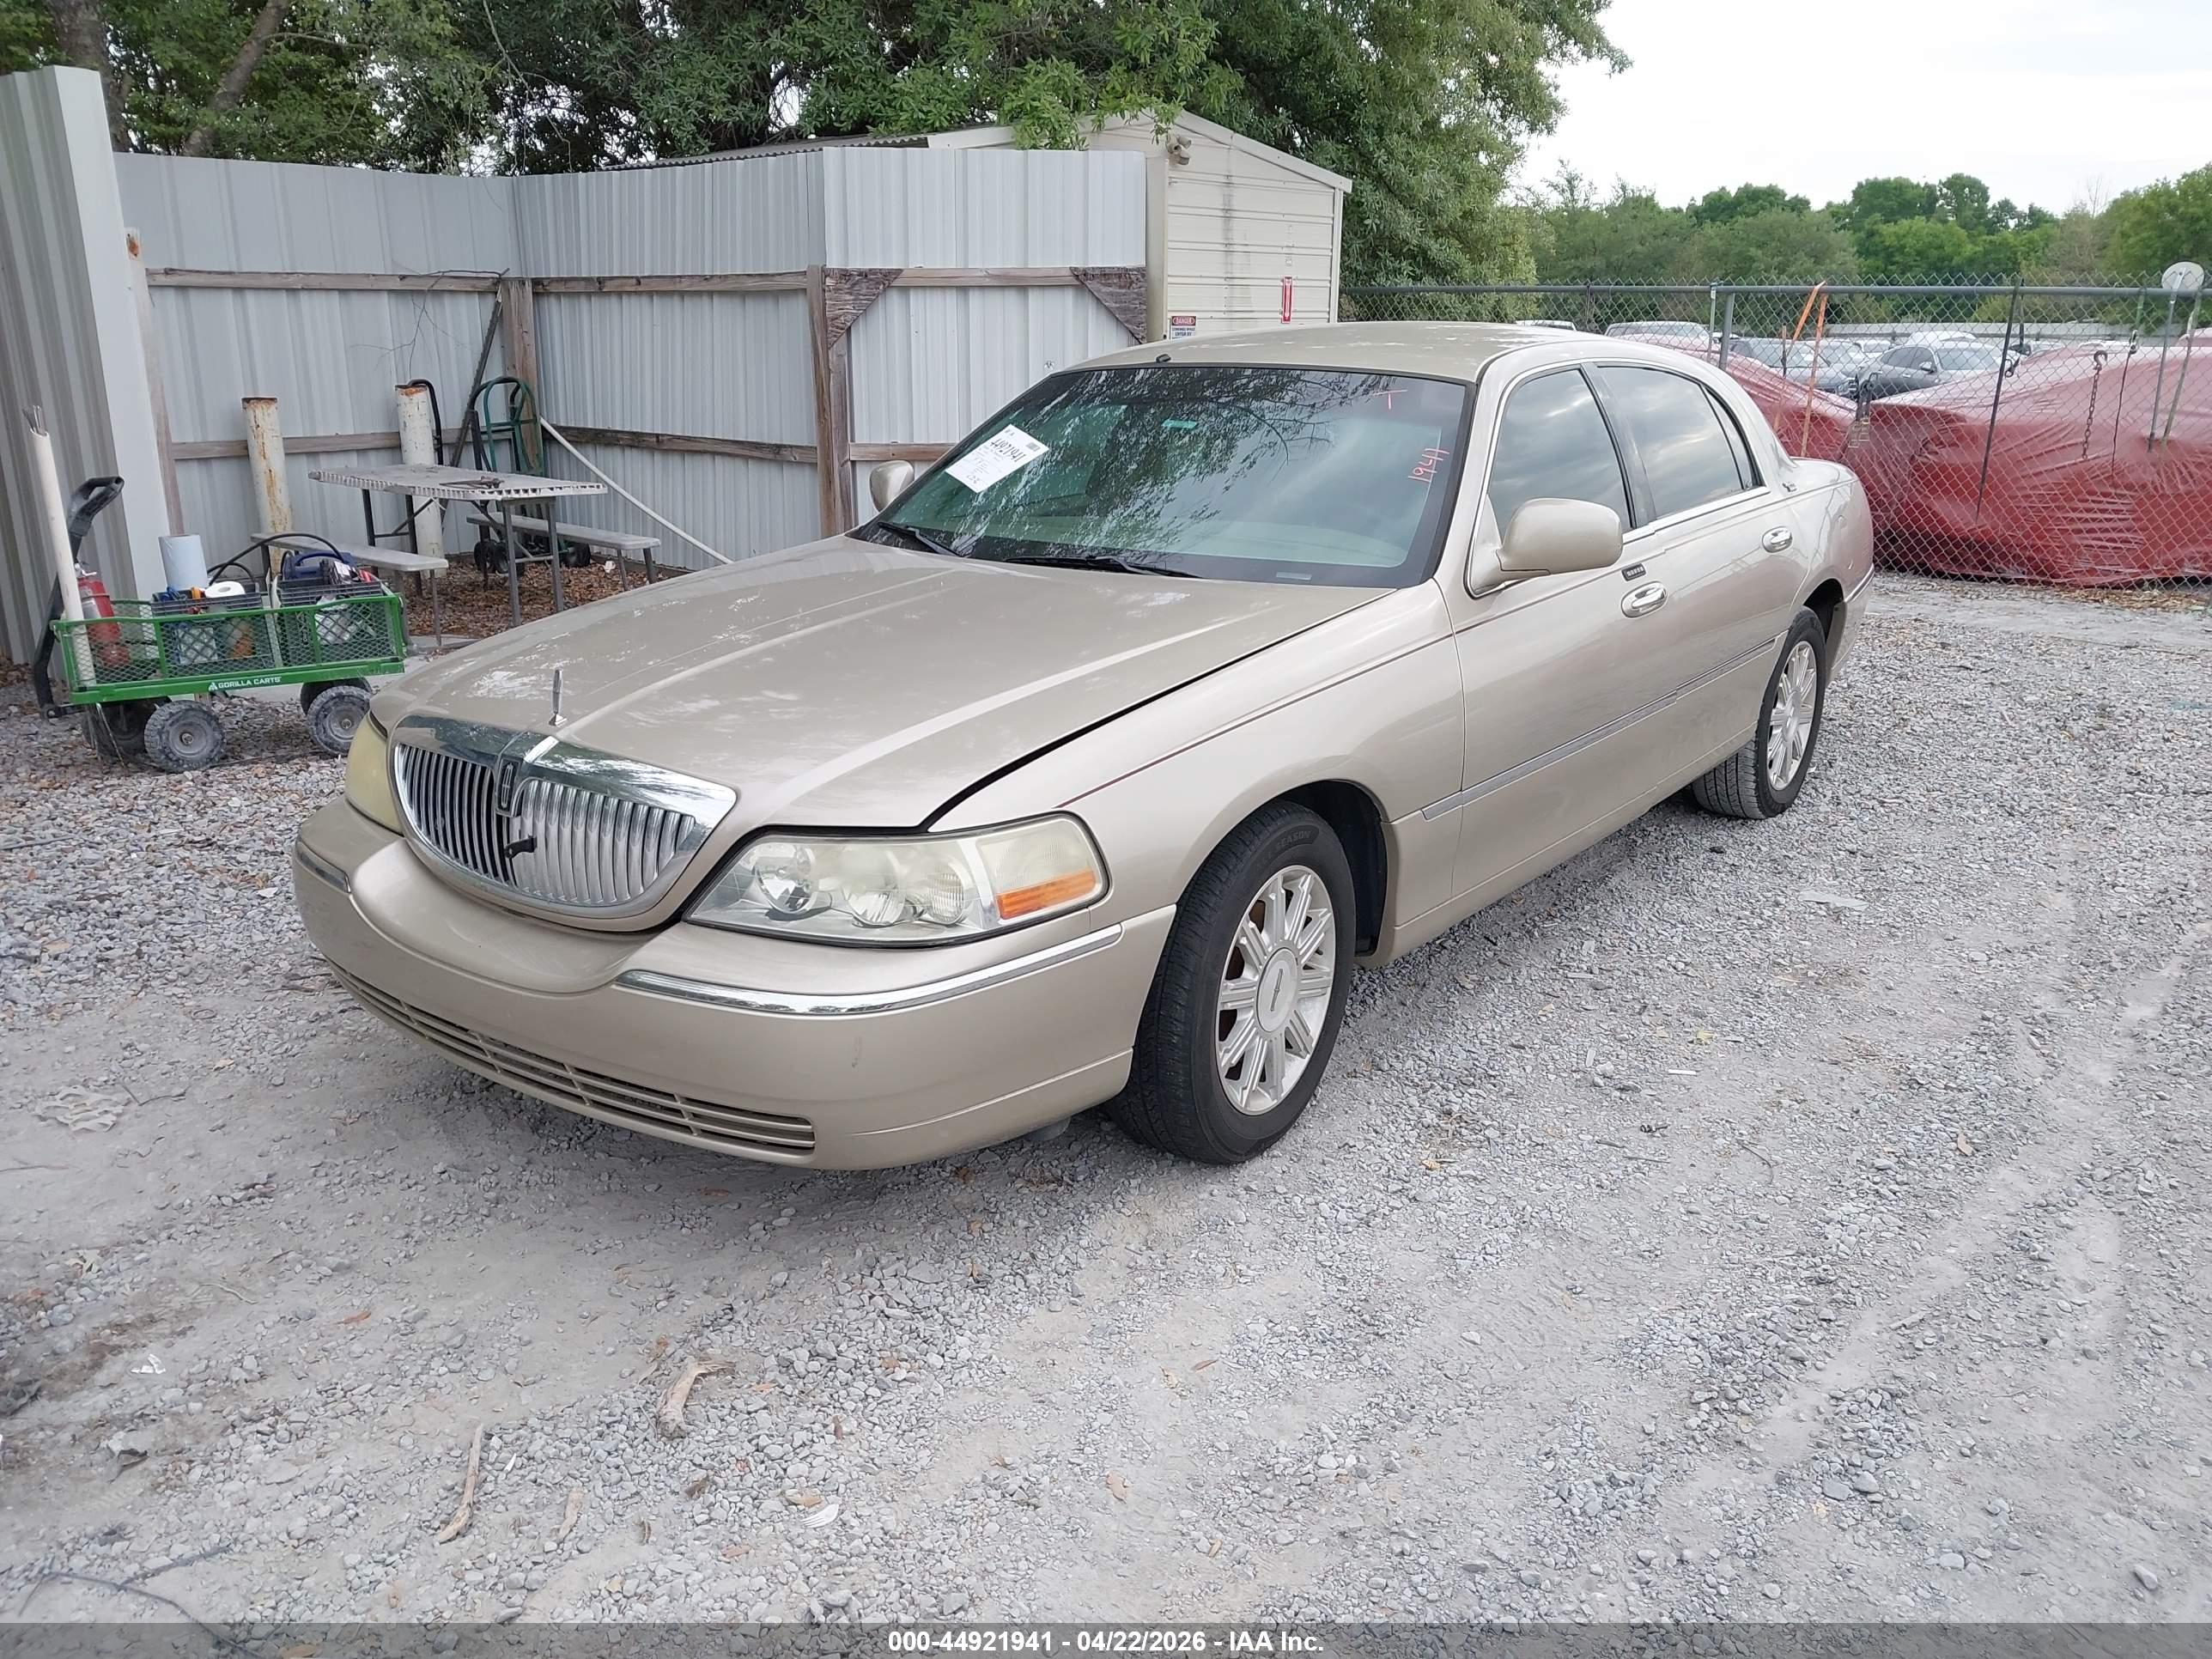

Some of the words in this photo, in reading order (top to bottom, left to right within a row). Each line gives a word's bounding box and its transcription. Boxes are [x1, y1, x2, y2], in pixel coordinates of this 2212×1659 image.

[1407, 447, 1450, 483] 1941
[217, 679, 252, 689] GORILLA
[253, 677, 282, 685] CARTS
